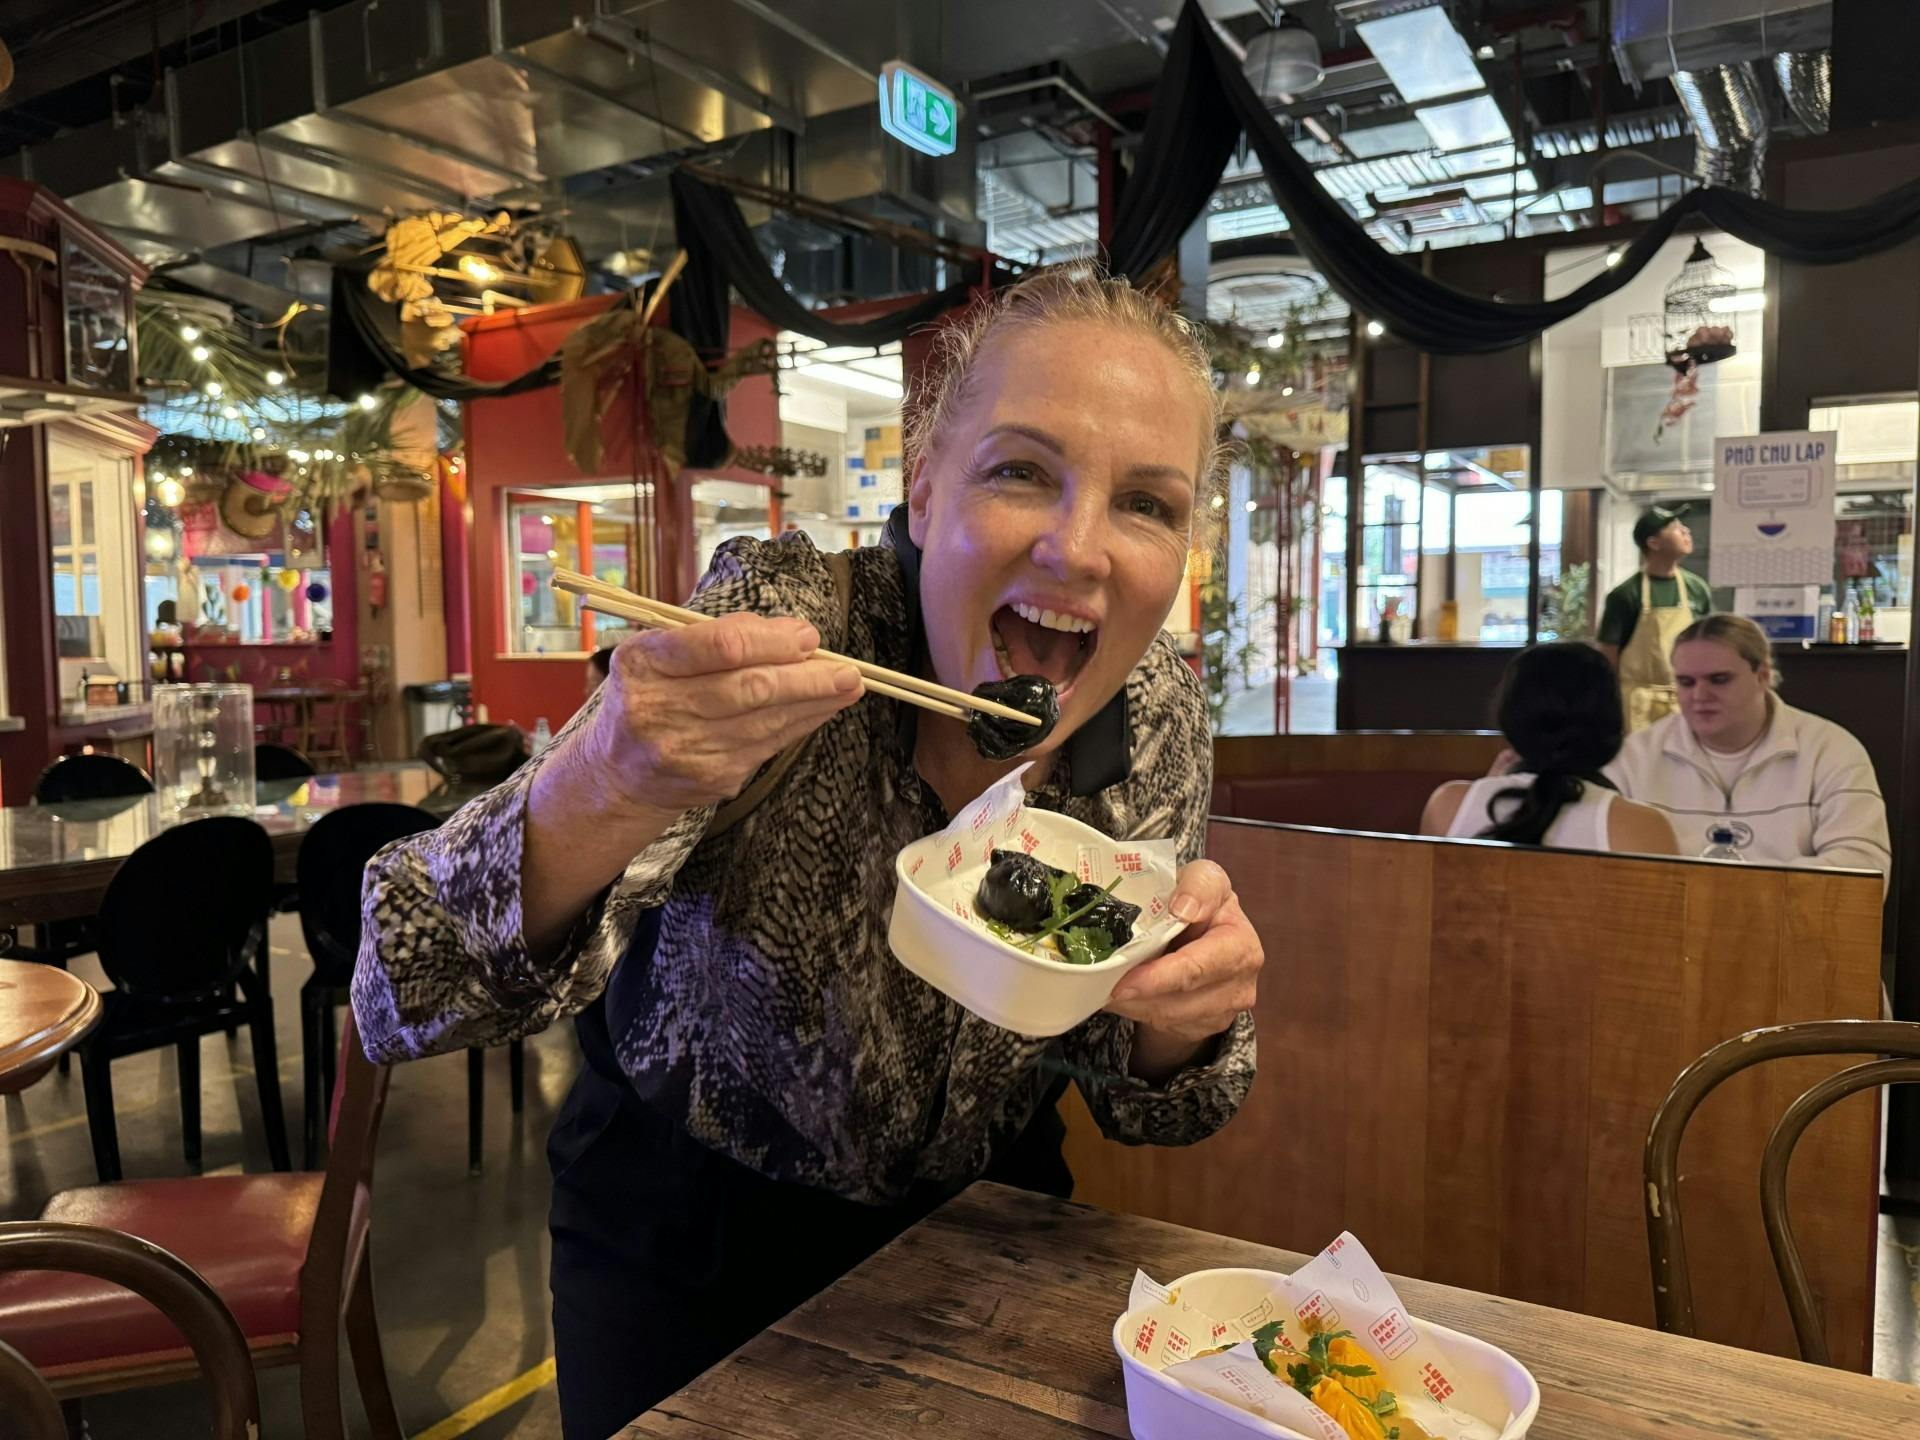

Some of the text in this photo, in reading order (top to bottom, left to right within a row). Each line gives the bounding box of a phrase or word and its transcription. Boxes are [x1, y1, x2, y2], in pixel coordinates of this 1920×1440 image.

[1796, 441, 1825, 462] LAP
[1114, 853, 1141, 863] LUKE
[1424, 1362, 1455, 1396] LUKE
